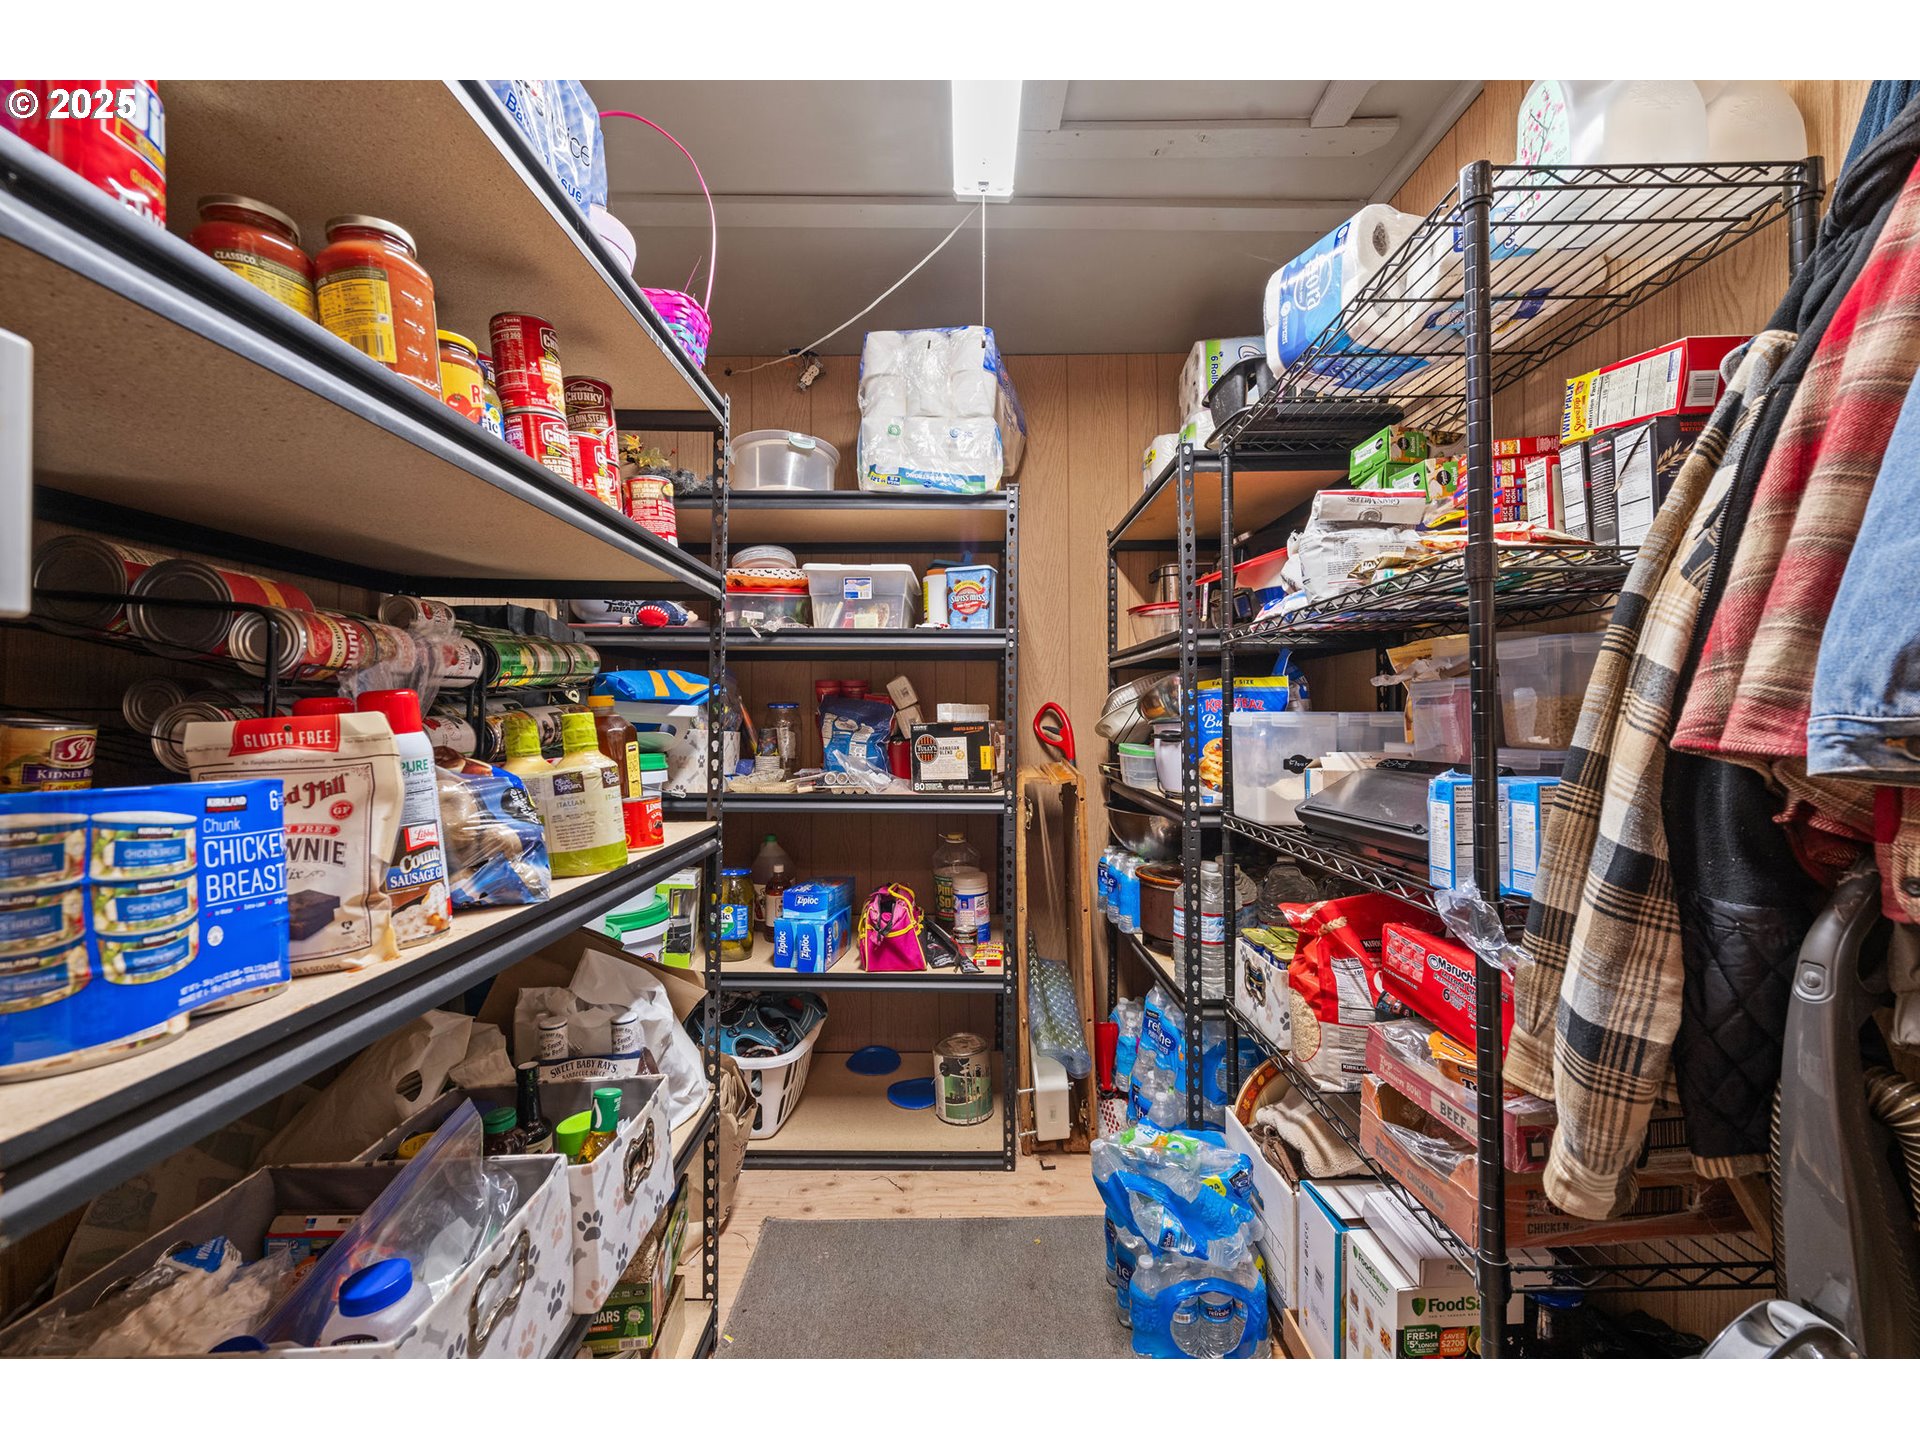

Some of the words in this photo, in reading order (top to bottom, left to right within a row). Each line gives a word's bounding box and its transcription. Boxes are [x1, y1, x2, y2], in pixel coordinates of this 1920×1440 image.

[214, 250, 256, 265] CLASSICO
[1210, 365, 1220, 385] Rolls
[1565, 382, 1576, 409] PACK
[1590, 377, 1598, 397] Facts
[565, 391, 603, 404] CHUNKY
[1587, 397, 1596, 429] Nutrition
[1561, 411, 1572, 439] TWIN
[604, 600, 640, 615] TREAT
[243, 731, 294, 749] GLUTEN
[299, 729, 332, 746] FREE
[37, 769, 83, 780] KIDNEY
[302, 773, 347, 810] Mill
[914, 782, 925, 791] 80
[269, 789, 279, 812] 6
[556, 799, 586, 808] ITALIAN
[203, 817, 241, 834] Chunk
[297, 825, 332, 834] FREE
[203, 834, 286, 868] CHICKEN
[285, 838, 345, 866] WNIE
[206, 863, 286, 903] BREAST
[390, 867, 435, 888] SAUSAGE
[795, 894, 819, 905] Ziploc
[779, 930, 788, 956] Ziploc
[800, 934, 811, 959] Ziploc
[1442, 988, 1450, 1002] 6
[550, 1061, 575, 1079] SWEET
[576, 1059, 596, 1069] BABY
[597, 1060, 618, 1074] RAY'S
[1342, 1063, 1369, 1072] KIRKLAN
[1406, 1081, 1423, 1101] BOWL
[1439, 1100, 1467, 1130] BEEF
[1527, 1221, 1570, 1236] CHICKEN
[1428, 1295, 1480, 1313] FoodS
[1406, 1331, 1438, 1341] FRESH
[1440, 1340, 1465, 1349] $2700
